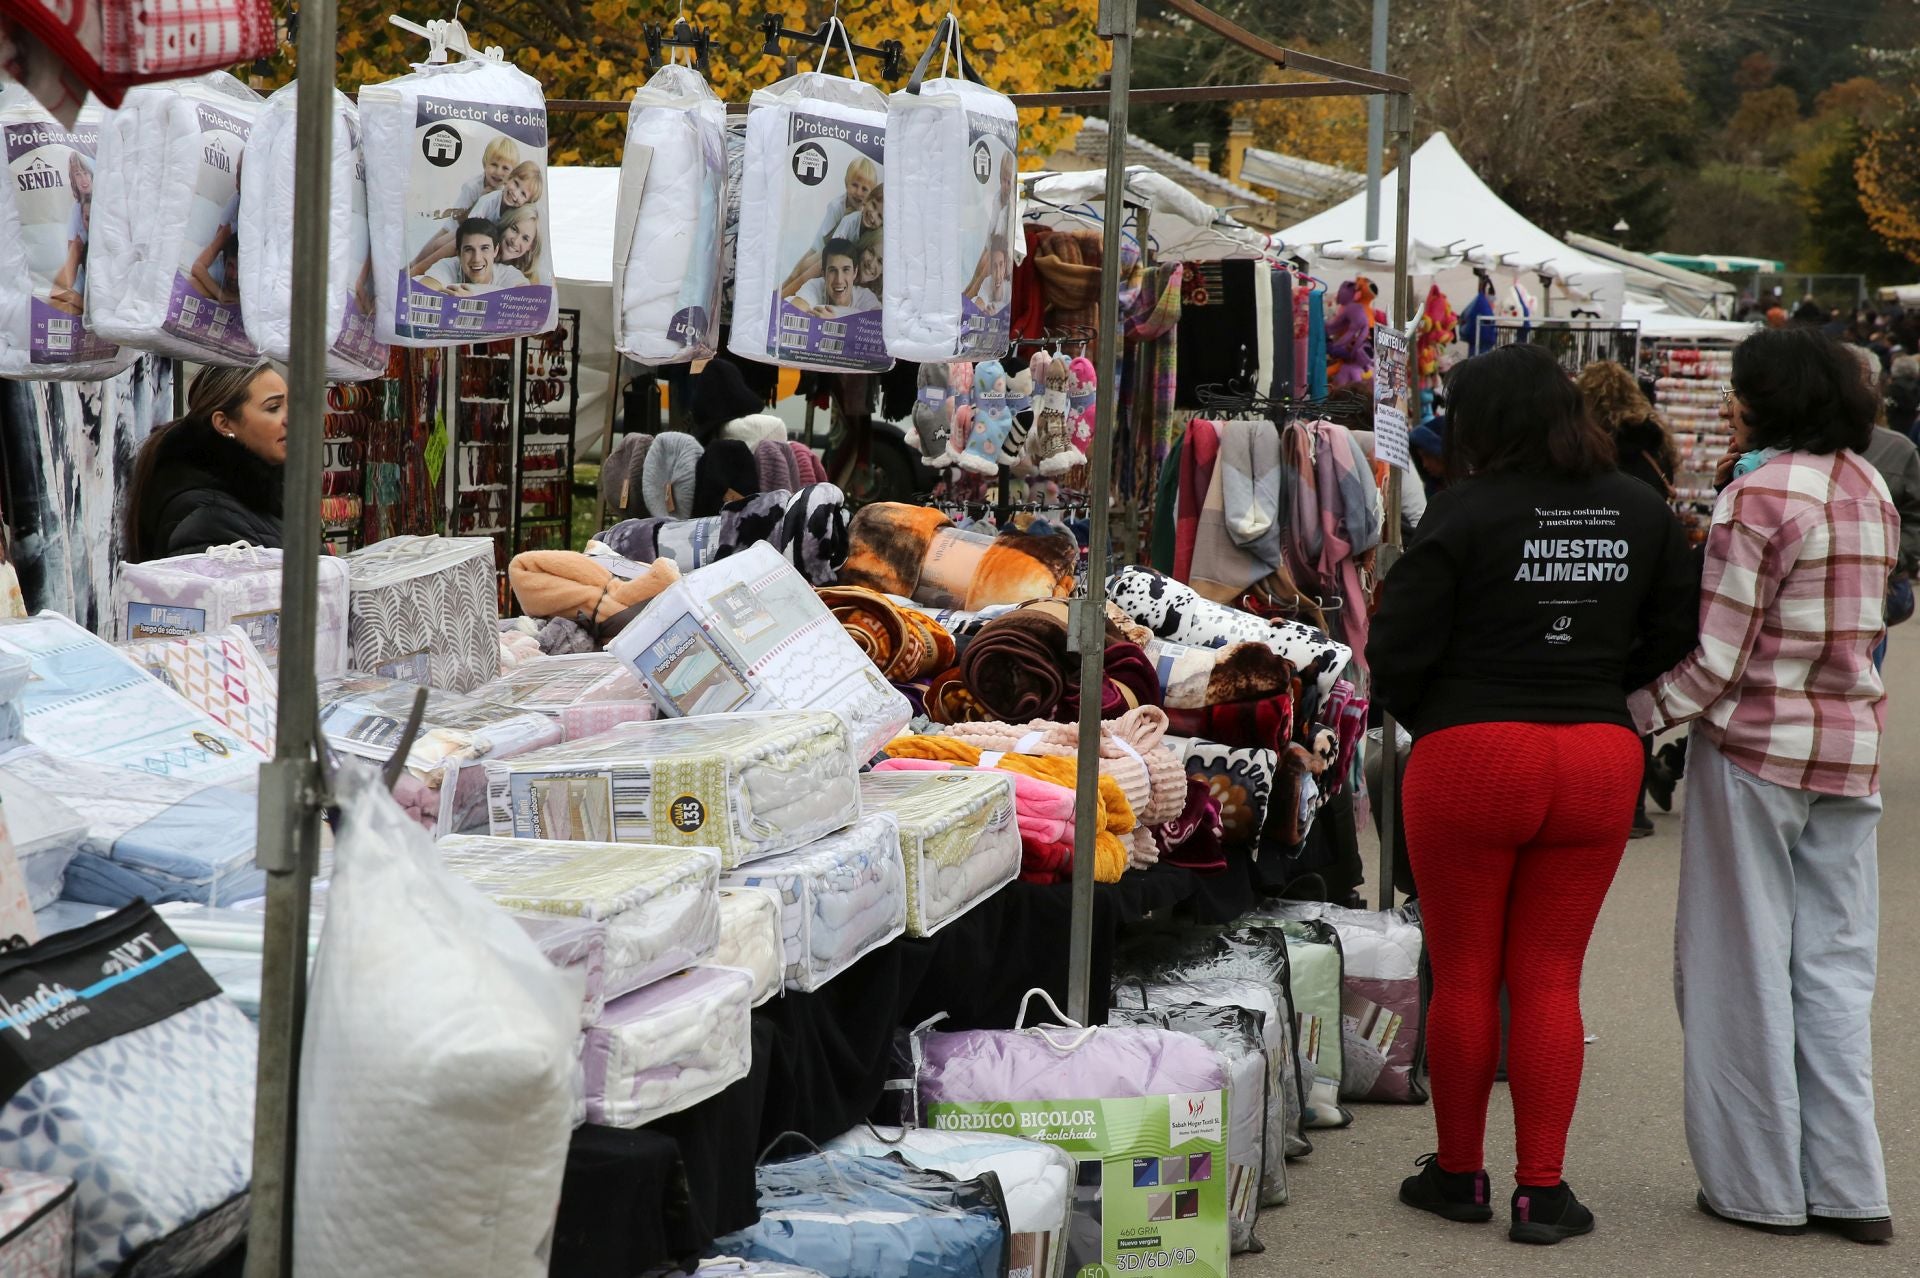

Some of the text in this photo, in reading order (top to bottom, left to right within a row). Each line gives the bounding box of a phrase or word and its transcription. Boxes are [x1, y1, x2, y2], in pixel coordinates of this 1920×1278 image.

[198, 107, 242, 135] Protector
[425, 101, 487, 121] Protector
[494, 109, 509, 123] de
[9, 129, 65, 147] Protector
[66, 132, 79, 143] de
[796, 118, 851, 140] Protector
[855, 129, 868, 144] de
[204, 146, 231, 174] SENDA
[17, 169, 64, 192] SENDA
[1378, 331, 1399, 351] SORTEO
[1535, 506, 1620, 517] Nuestras costumbres
[1539, 519, 1544, 529] y
[1546, 518, 1583, 526] nuestros
[1523, 539, 1629, 559] NUESTRO
[1513, 562, 1629, 582] ALIMENTO
[140, 622, 158, 636] Juego
[157, 624, 166, 634] de
[668, 651, 677, 662] de
[533, 814, 540, 823] de
[674, 802, 684, 826] CAMA
[683, 802, 700, 826] 135
[935, 1109, 1097, 1130] NÓRDICO BICOLOR
[1172, 1120, 1187, 1128] Sabah
[1187, 1120, 1202, 1128] Hogar
[1029, 1127, 1097, 1141] Acolchado
[1120, 1226, 1159, 1237] 460 GRM
[1120, 1238, 1159, 1247] Nuevo vergine
[1116, 1247, 1196, 1271] 3D/6D/9D
[1083, 1268, 1104, 1278] 150
